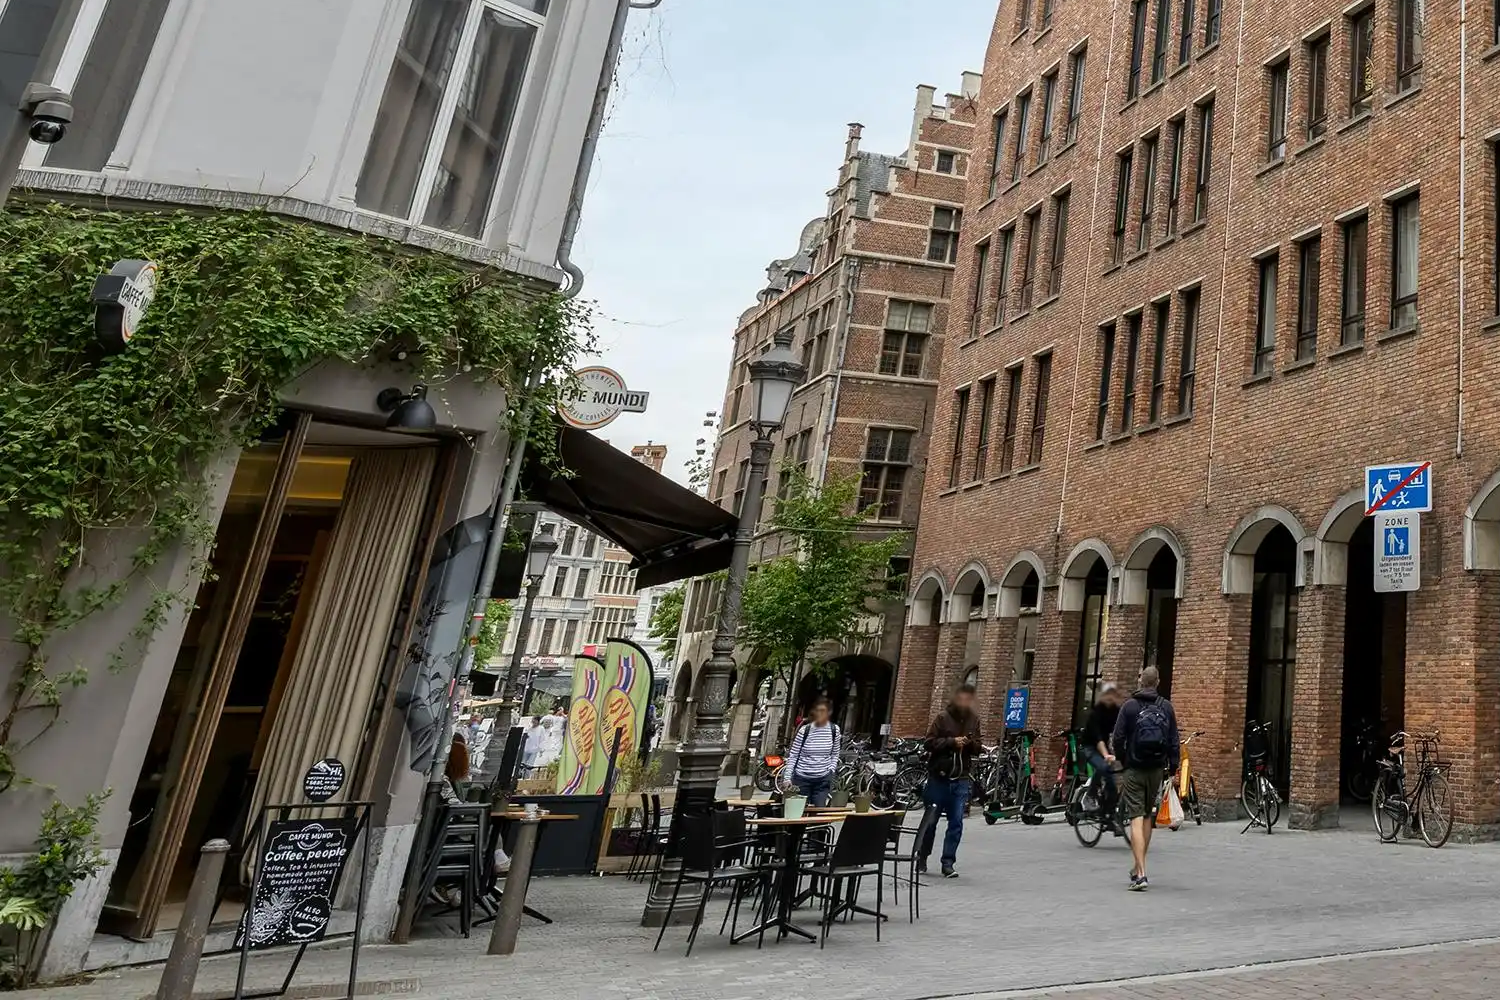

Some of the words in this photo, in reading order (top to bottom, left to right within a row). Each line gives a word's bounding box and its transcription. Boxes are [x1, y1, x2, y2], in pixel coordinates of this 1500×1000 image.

[593, 391, 645, 407] MUNDI
[1385, 518, 1408, 526] ZONE
[330, 767, 343, 776] Hi,
[289, 833, 310, 841] CAFFE
[311, 832, 333, 840] MUNDI
[265, 851, 305, 862] Coffee,
[307, 847, 347, 860] people
[305, 869, 333, 877] pastries
[304, 905, 321, 915] ALSO
